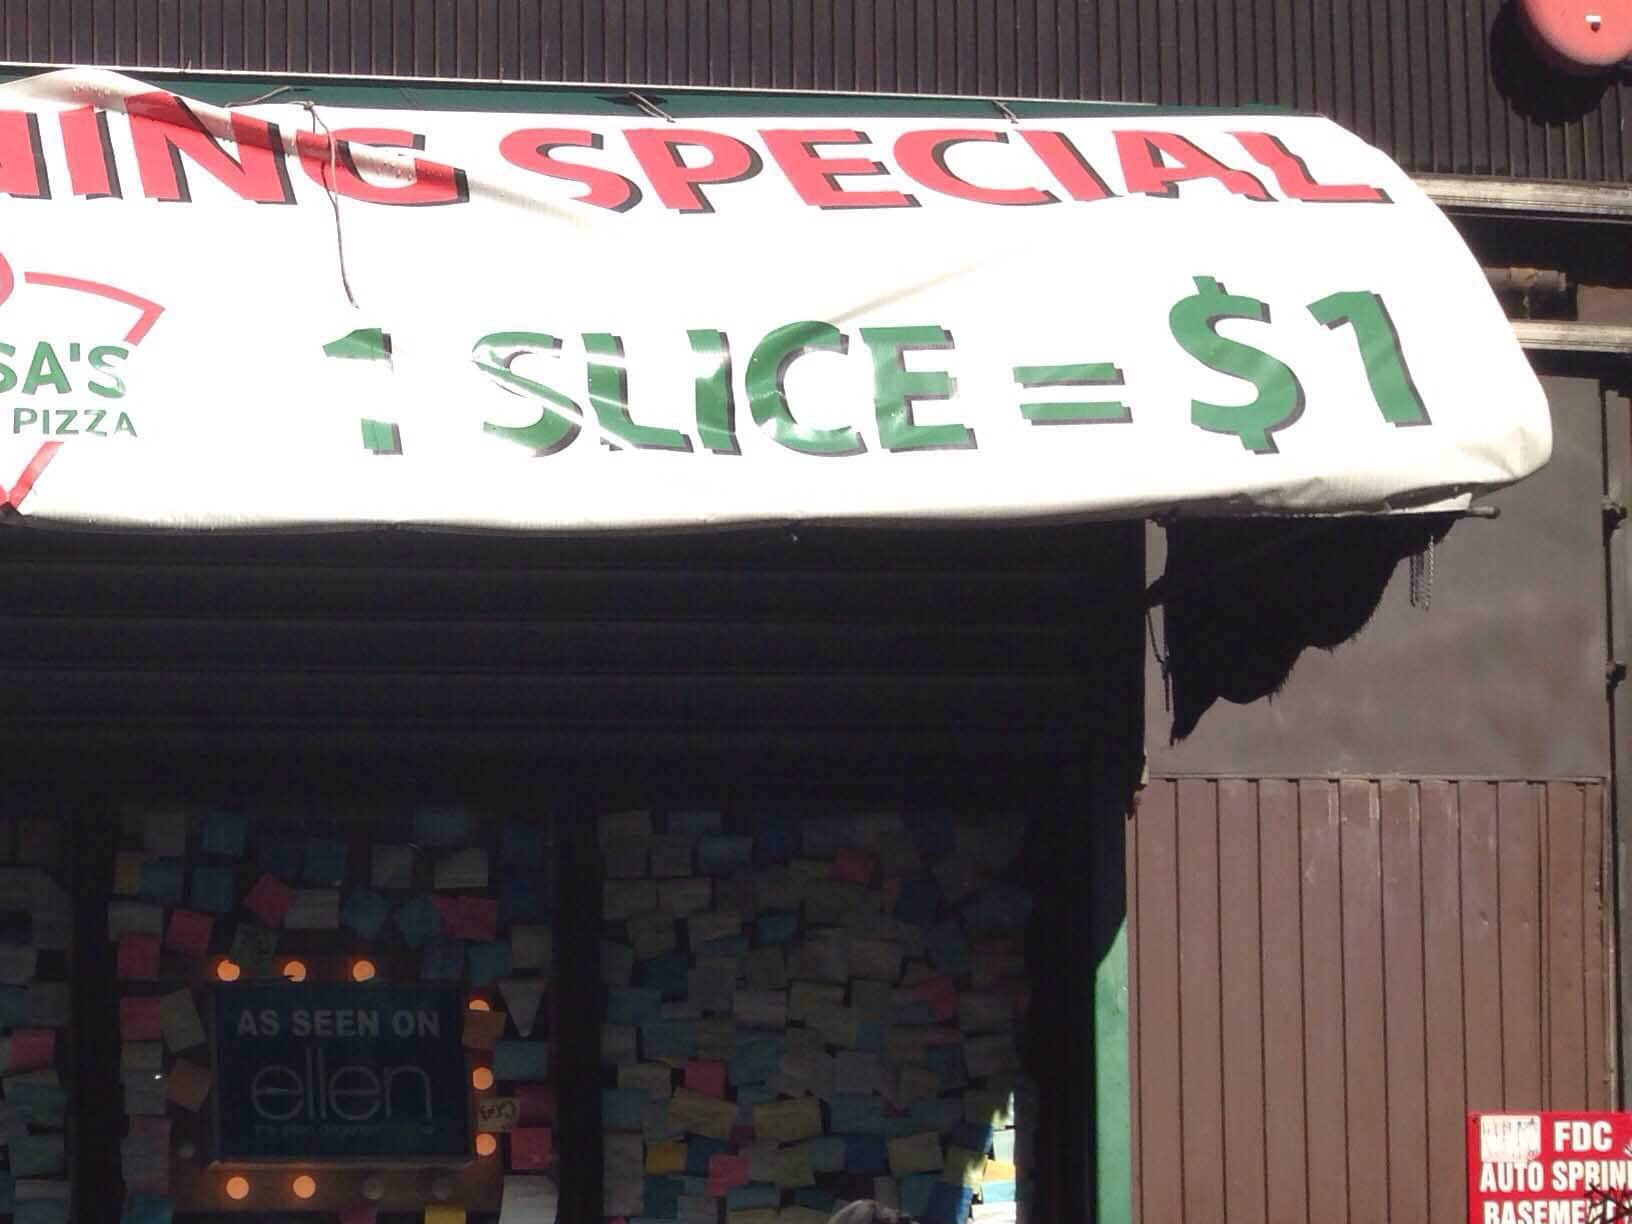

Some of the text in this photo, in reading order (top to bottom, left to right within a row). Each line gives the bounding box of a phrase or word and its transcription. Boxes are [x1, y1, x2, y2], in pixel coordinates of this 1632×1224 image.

[498, 126, 1395, 214] SPECIAL
[471, 320, 979, 458] SLICE
[1168, 275, 1432, 454] $1
[13, 407, 138, 438] PIZZA
[237, 1008, 441, 1038] AS SEEN ON
[249, 1047, 433, 1121] ellen
[1553, 1120, 1614, 1153] FDC
[1479, 1160, 1632, 1192] AUTO SPRIN
